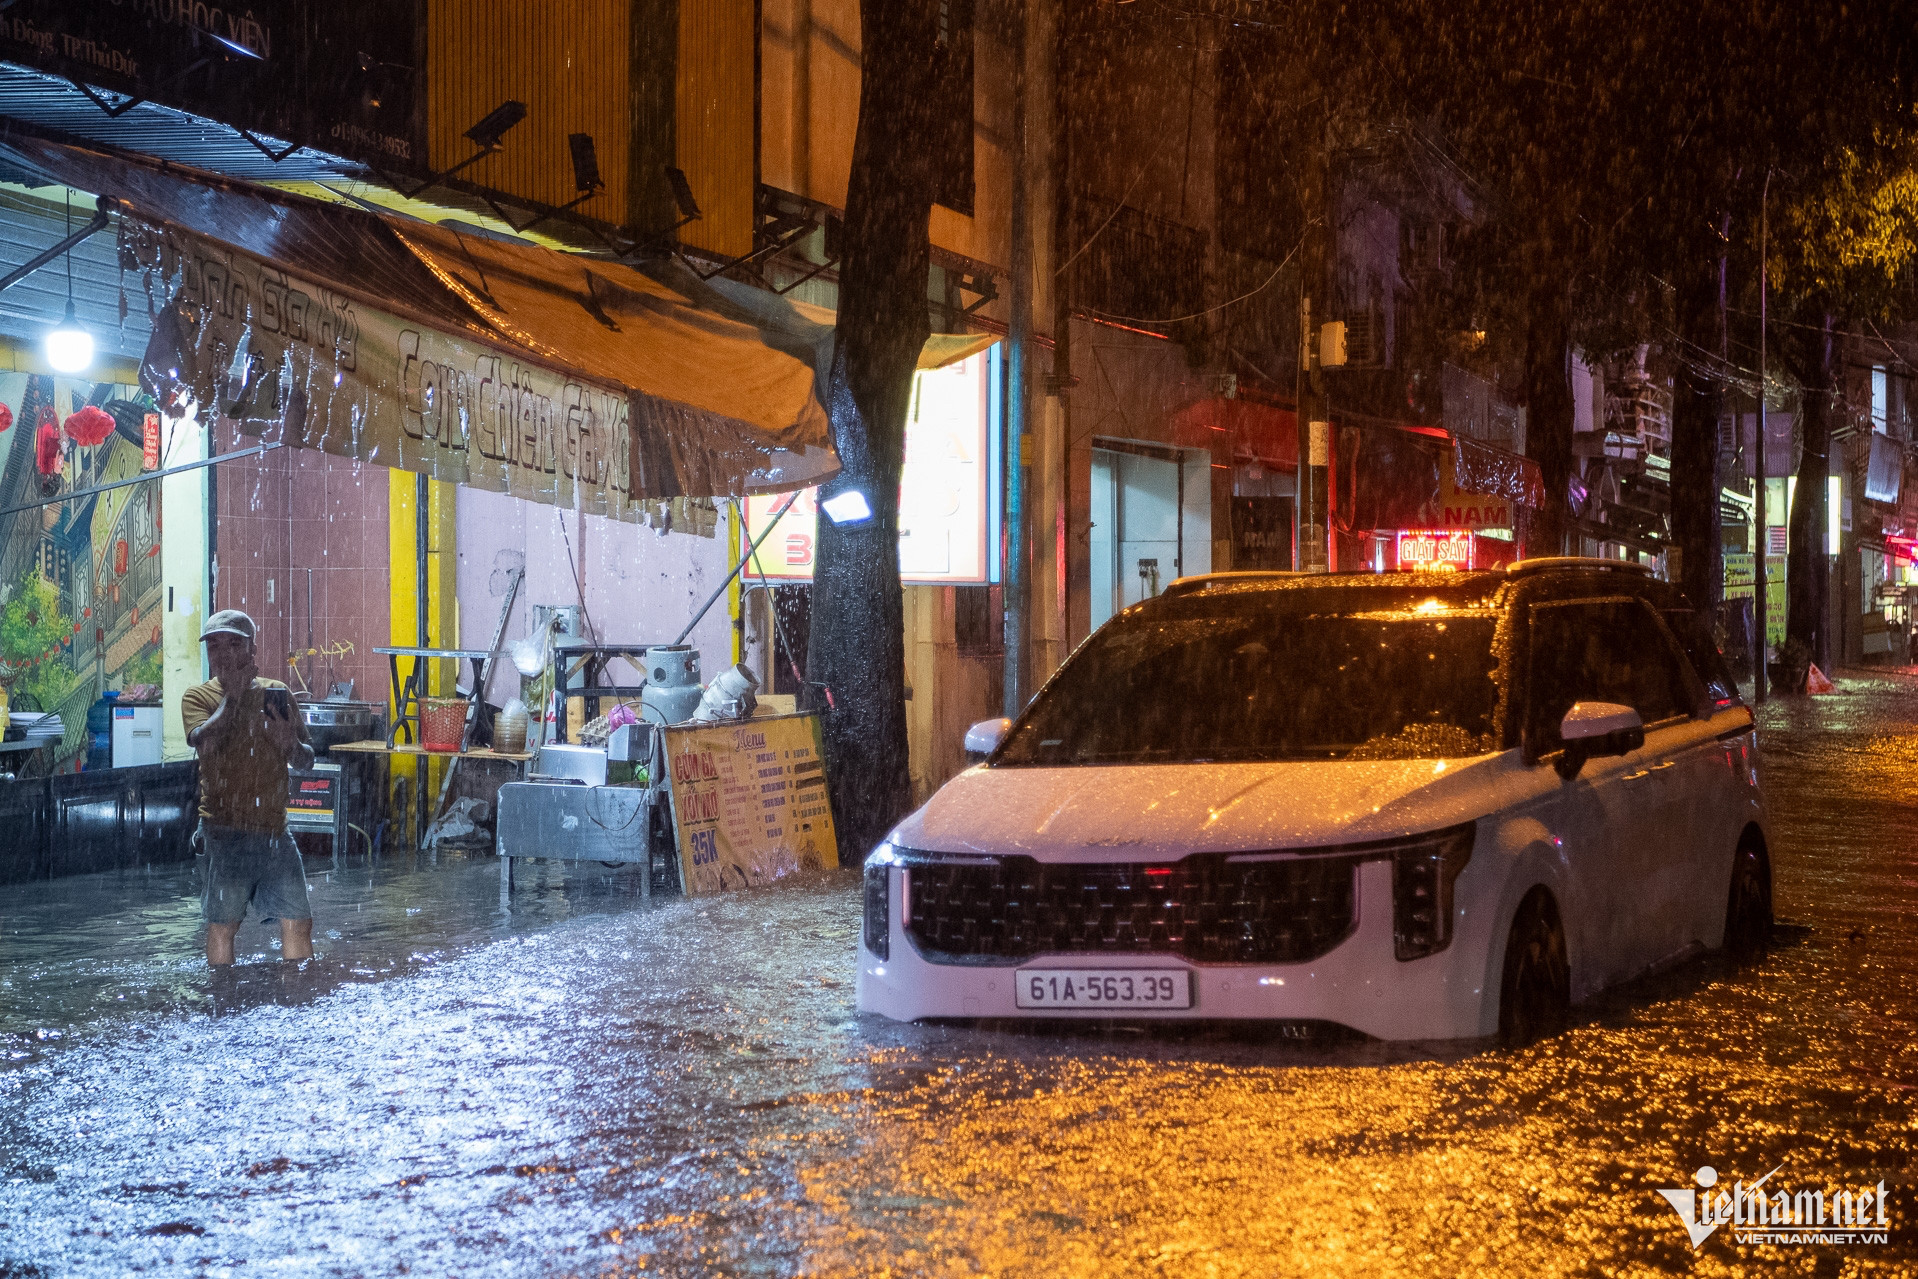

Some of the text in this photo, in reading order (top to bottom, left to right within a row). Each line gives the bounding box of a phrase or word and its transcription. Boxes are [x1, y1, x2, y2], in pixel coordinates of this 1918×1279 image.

[474, 353, 556, 474] Chiên
[1444, 506, 1508, 525] NAM
[732, 728, 767, 752] Menu
[690, 827, 719, 867] 35K
[1030, 976, 1174, 1002] 61A-563.39
